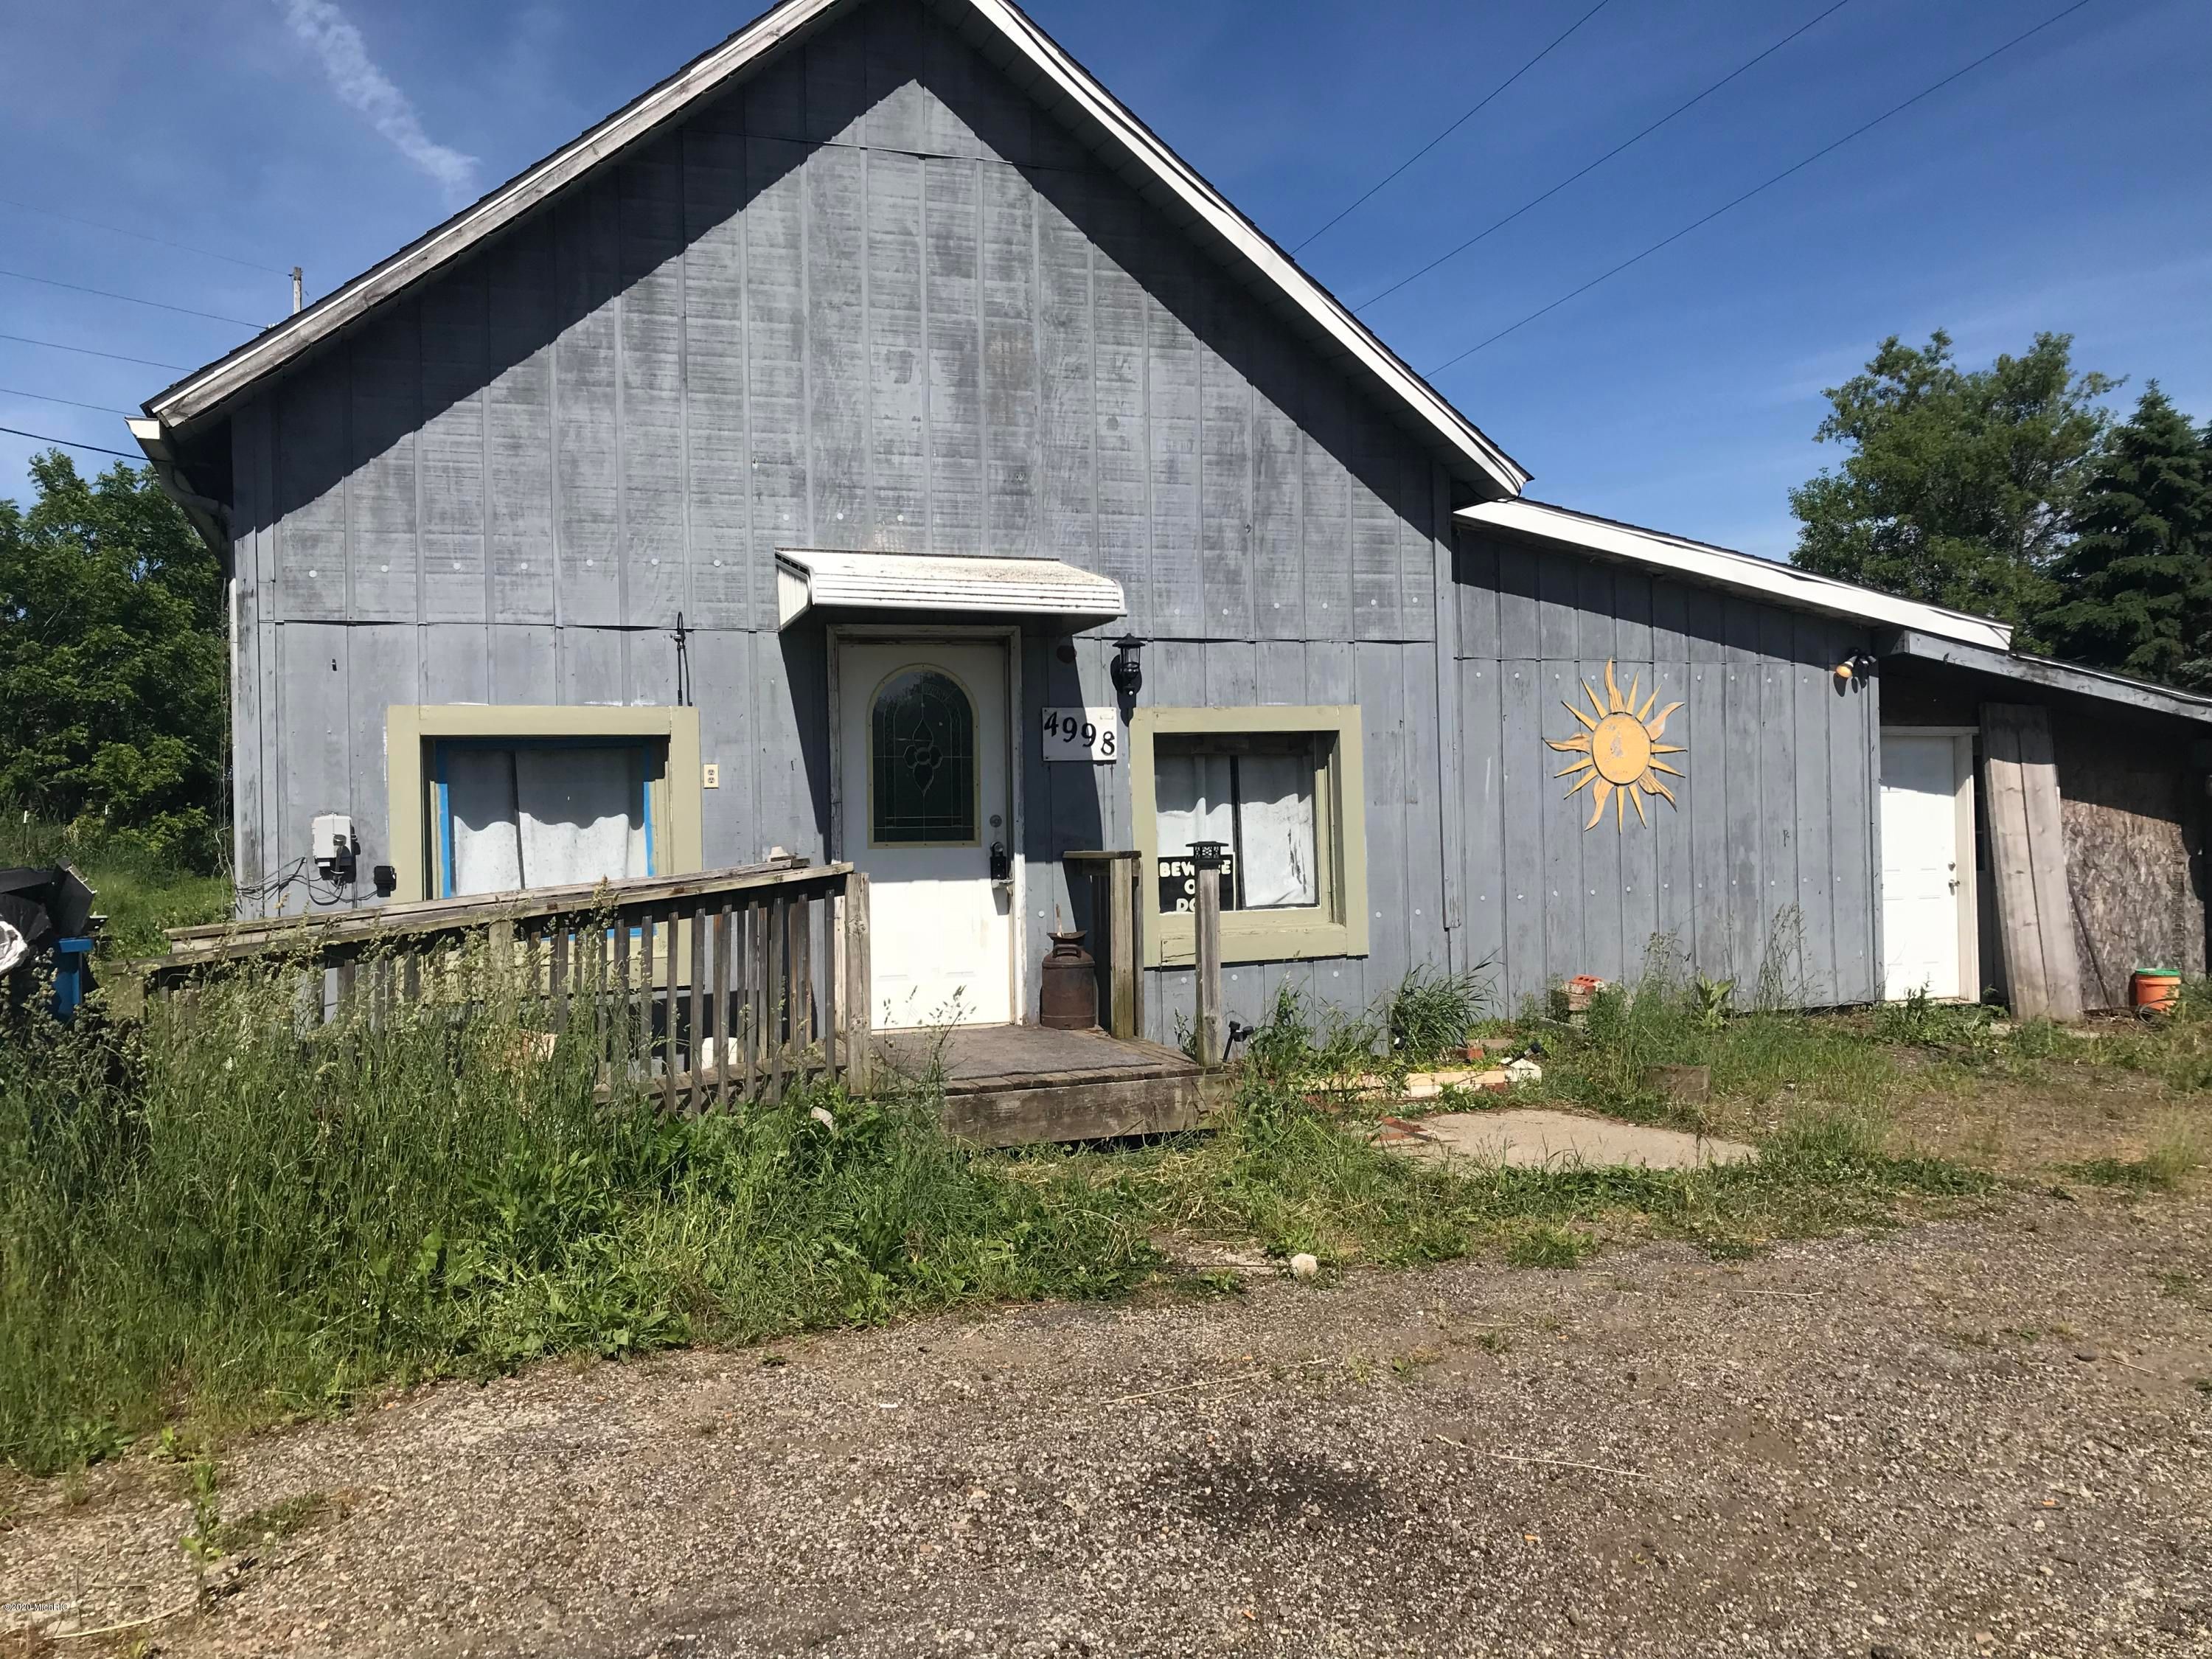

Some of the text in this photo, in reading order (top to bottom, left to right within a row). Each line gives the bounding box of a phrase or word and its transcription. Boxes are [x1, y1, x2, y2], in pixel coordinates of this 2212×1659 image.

[1044, 712, 1115, 756] 4998
[1159, 860, 1231, 877] BEWE
[1184, 879, 1195, 894] O
